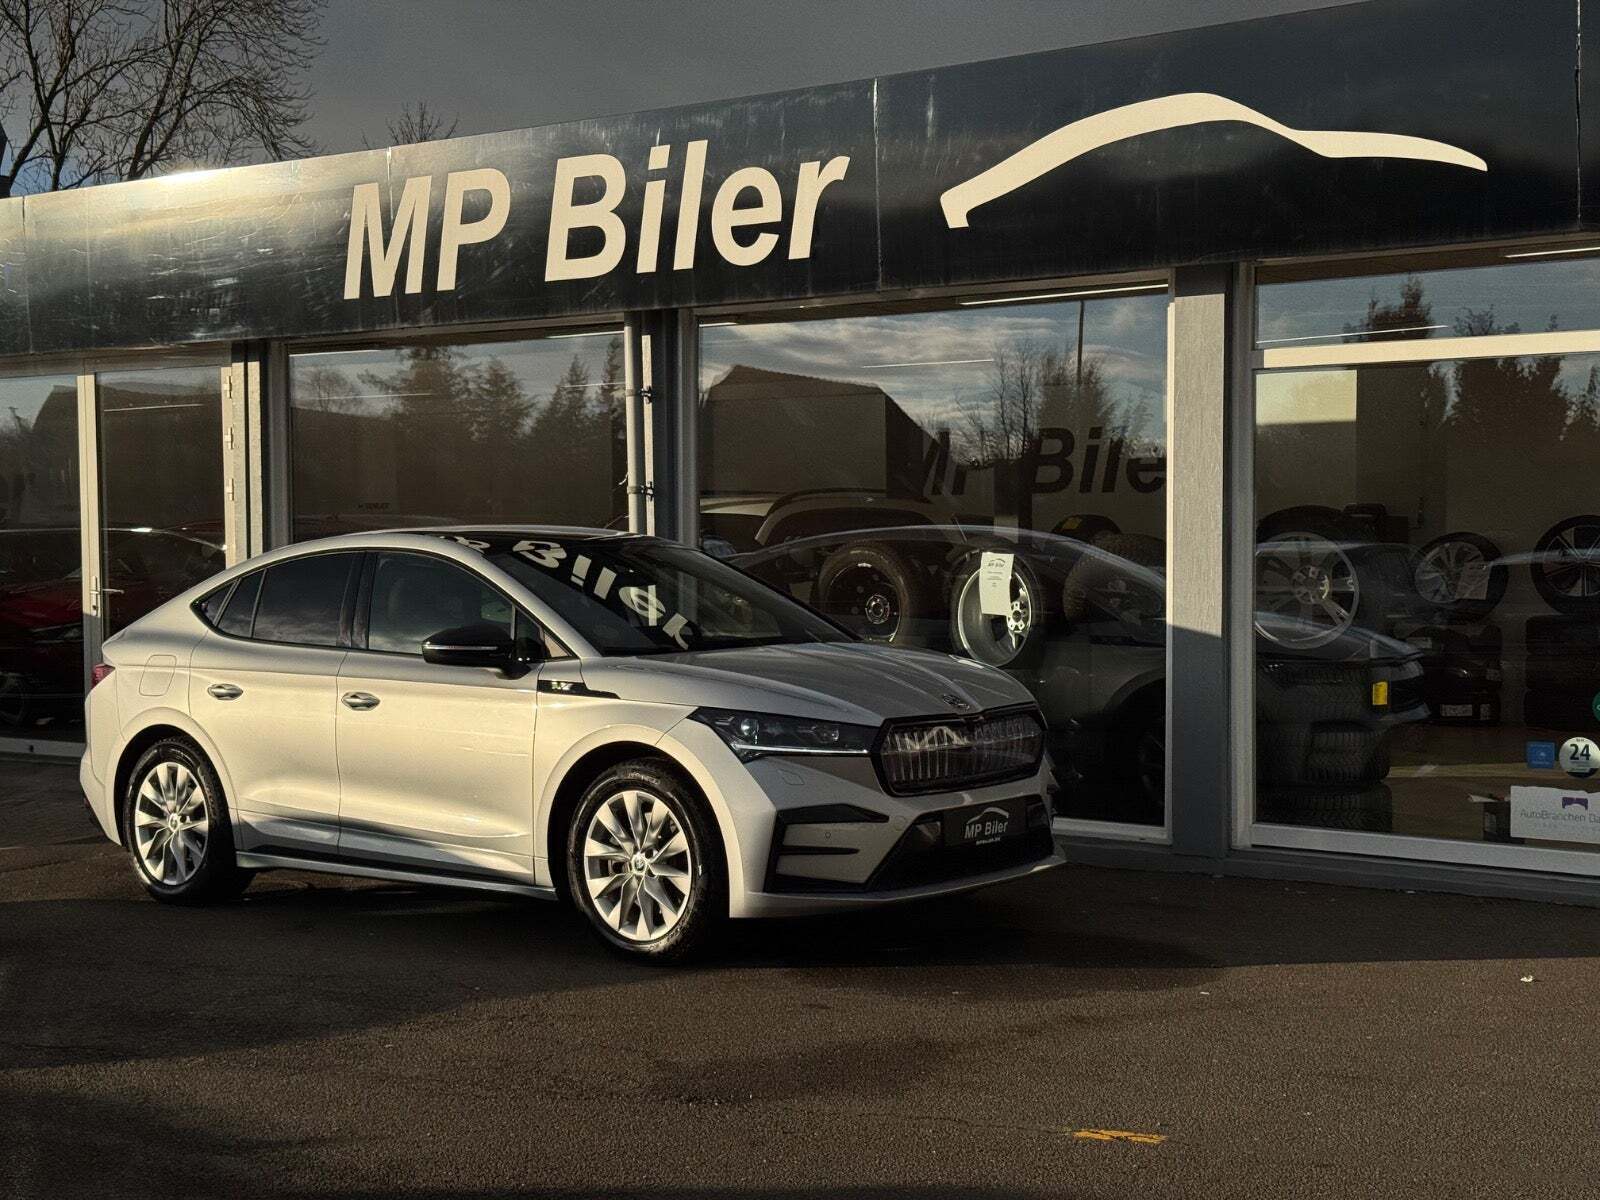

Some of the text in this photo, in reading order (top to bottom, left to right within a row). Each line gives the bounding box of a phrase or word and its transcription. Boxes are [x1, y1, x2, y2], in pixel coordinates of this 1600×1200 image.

[343, 139, 849, 300] MP Biler
[1569, 743, 1590, 761] 24
[964, 819, 1009, 839] MP Biler
